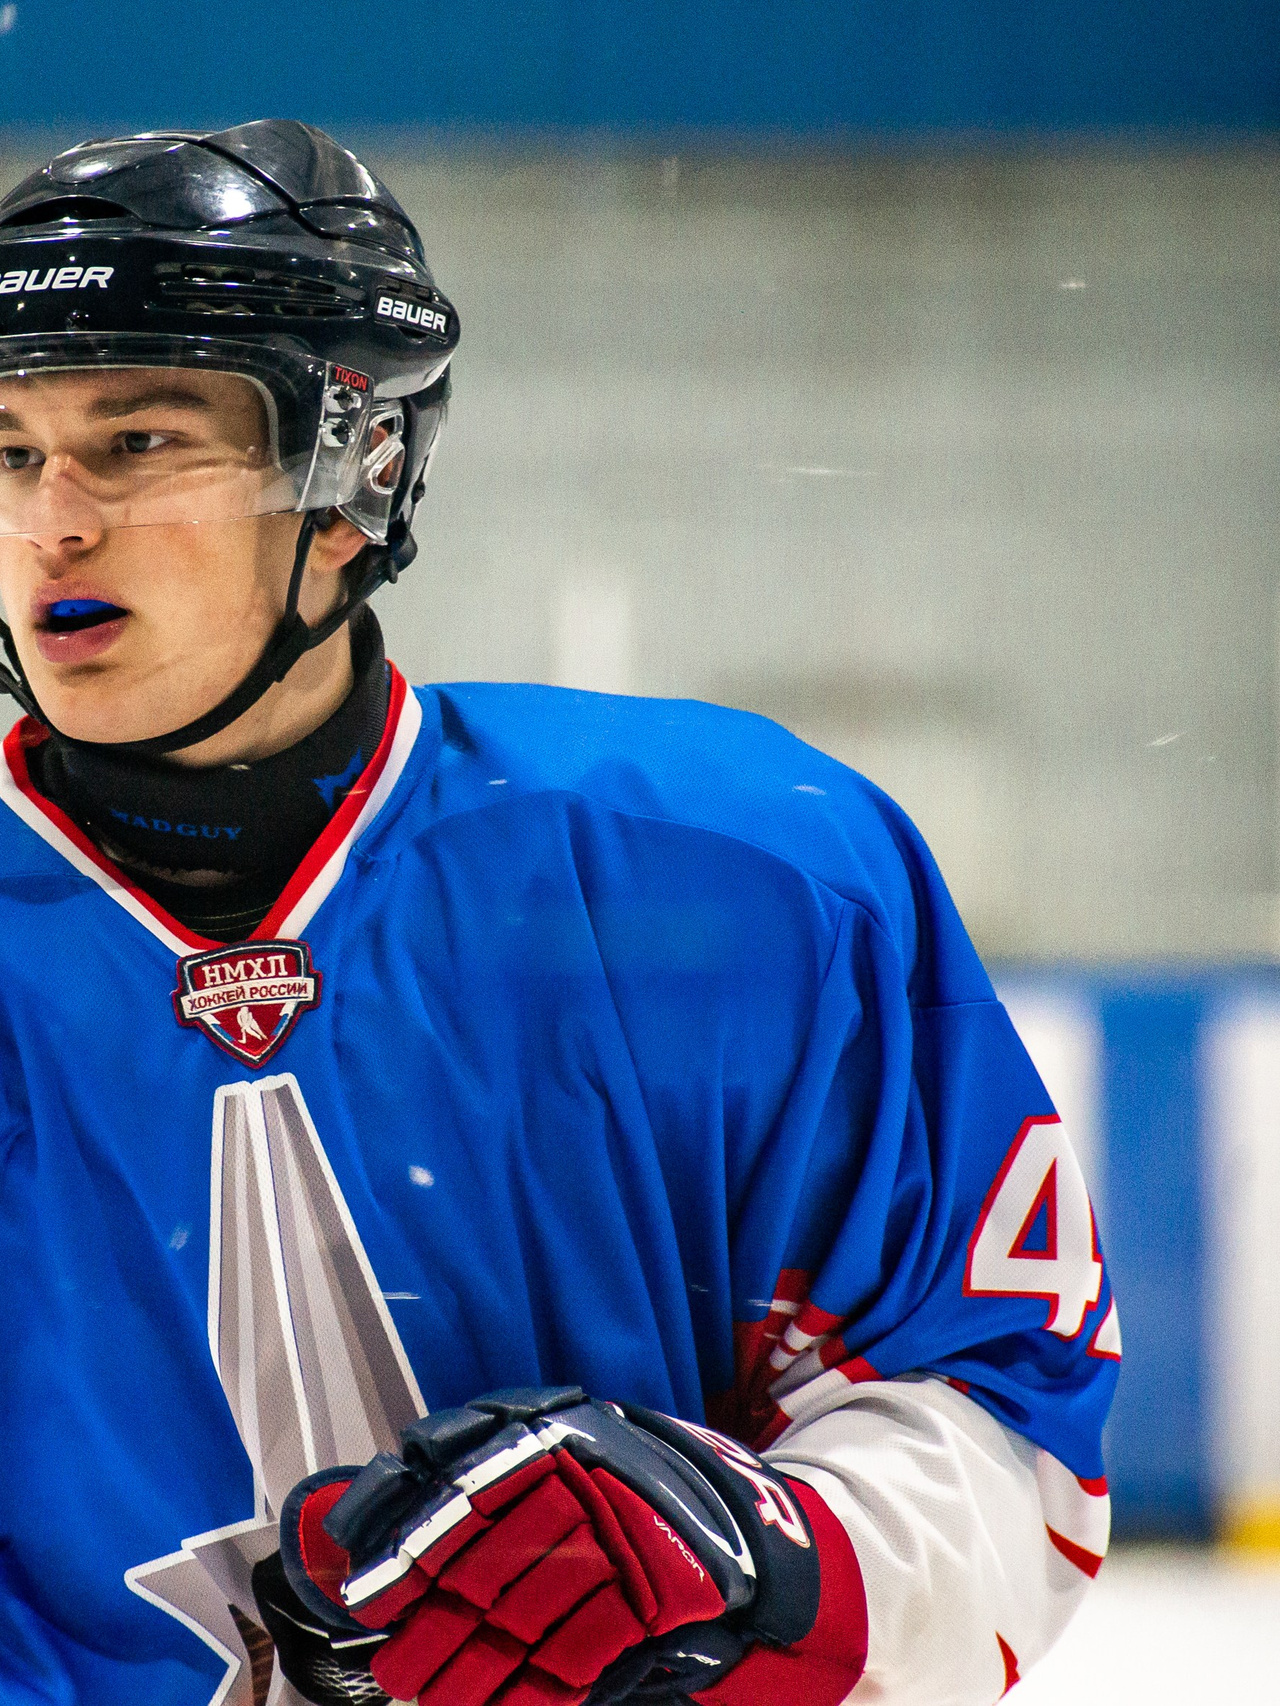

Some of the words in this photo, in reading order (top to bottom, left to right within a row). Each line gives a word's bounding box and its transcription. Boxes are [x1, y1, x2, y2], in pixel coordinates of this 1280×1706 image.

[377, 296, 446, 333] BAUER
[335, 366, 368, 391] TIXON
[202, 955, 288, 987] НМХЛ
[188, 986, 246, 1011] ХОККЕЙ
[250, 982, 308, 999] РОССИИ
